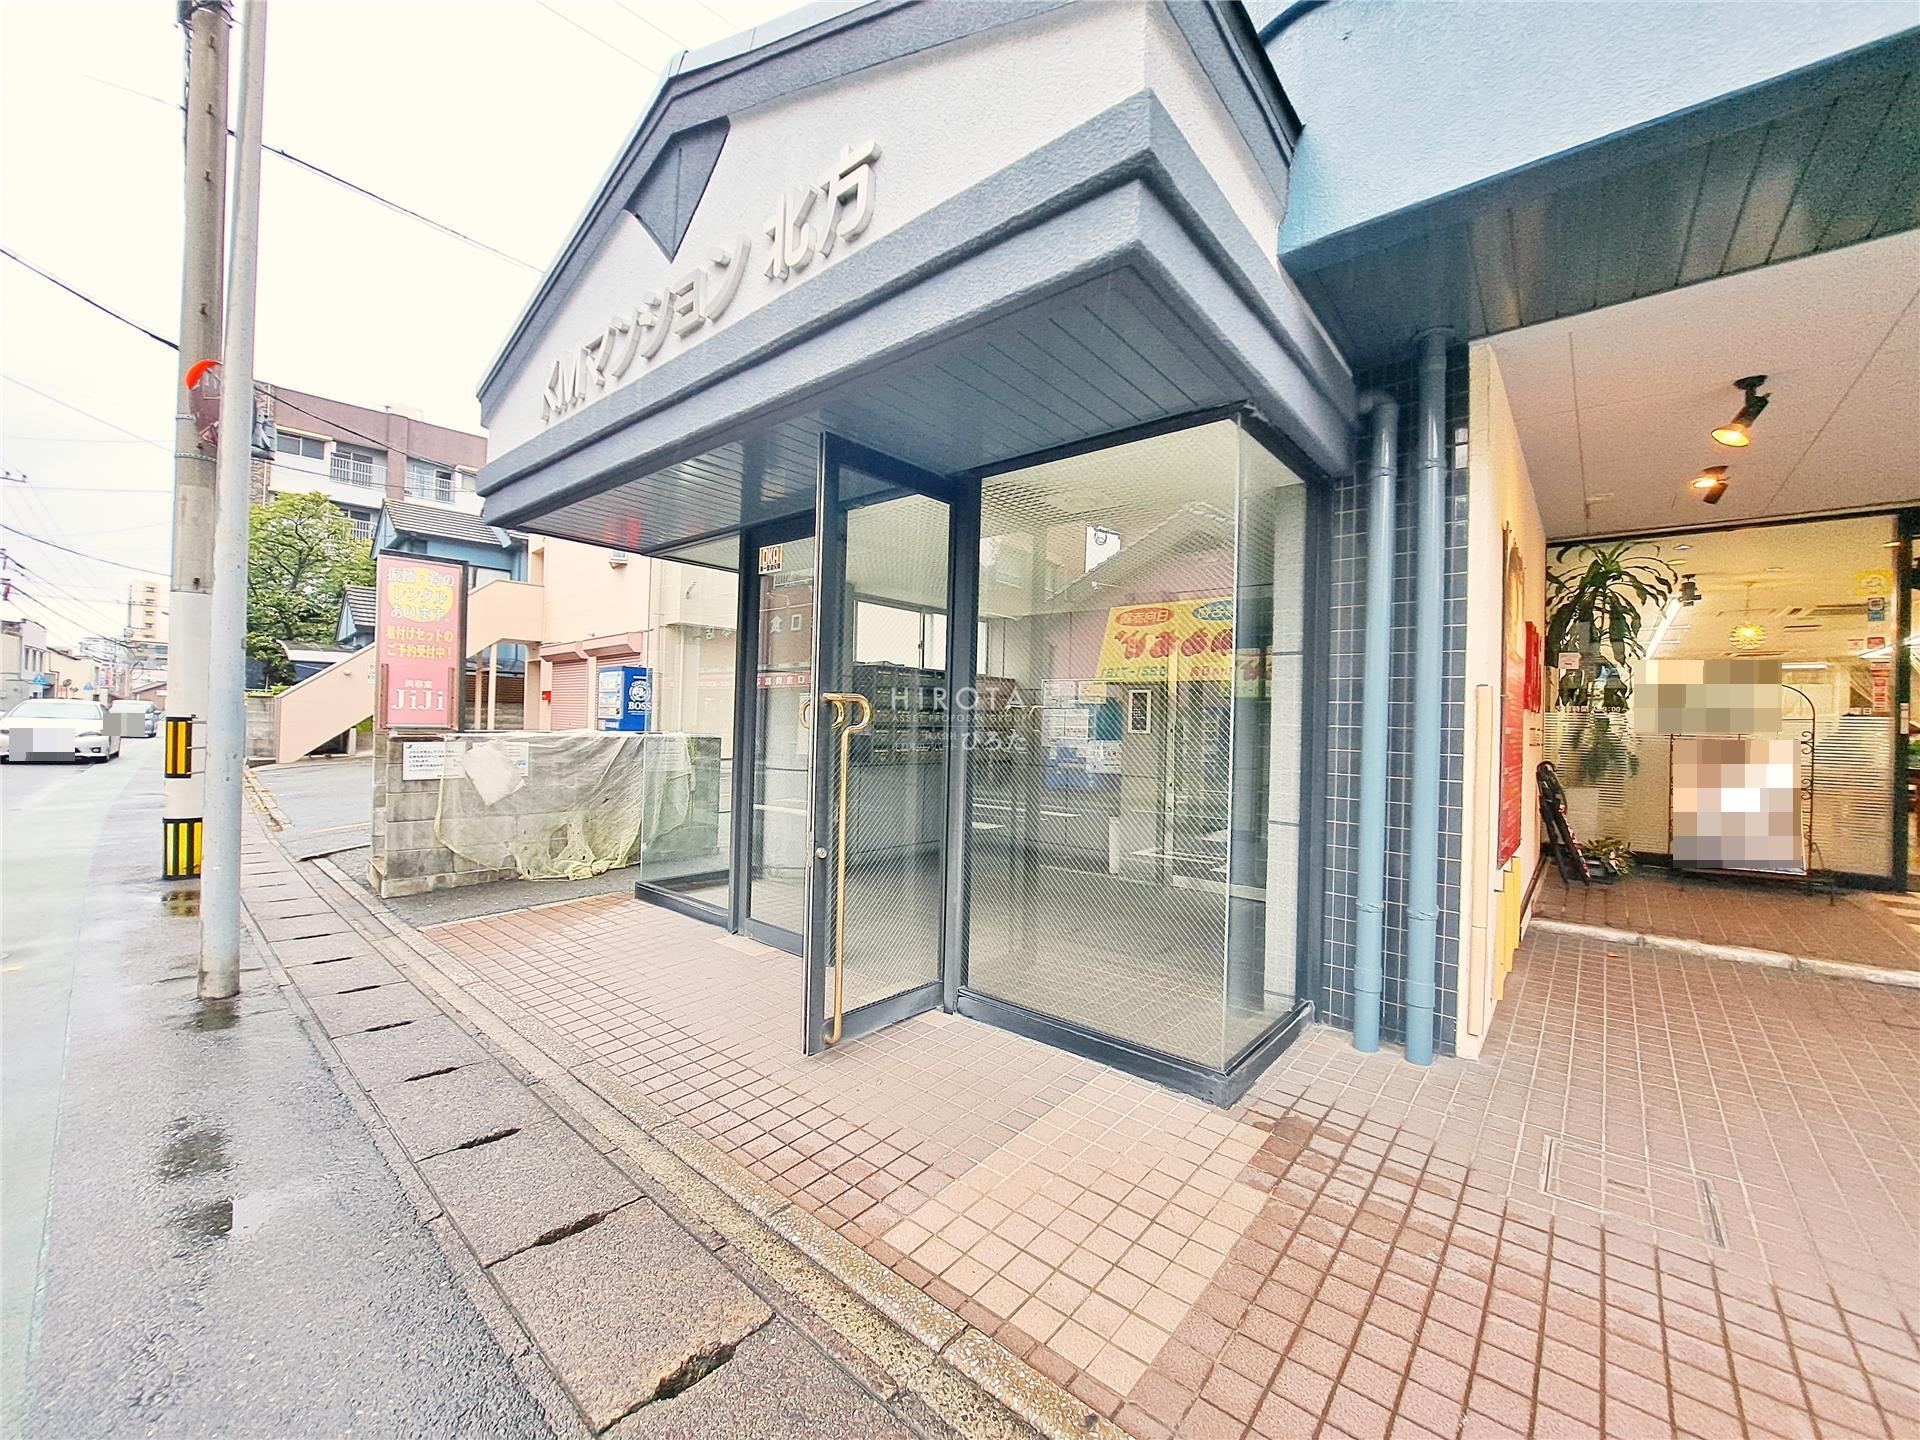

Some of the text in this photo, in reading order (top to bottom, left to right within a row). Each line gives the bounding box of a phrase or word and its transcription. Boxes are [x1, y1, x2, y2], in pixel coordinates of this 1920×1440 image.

[764, 139, 883, 281] 北方
[393, 586, 448, 605] レンタル
[386, 624, 454, 642] 着付けセットの
[390, 689, 445, 711] JiJi
[627, 701, 652, 711] BOSS
